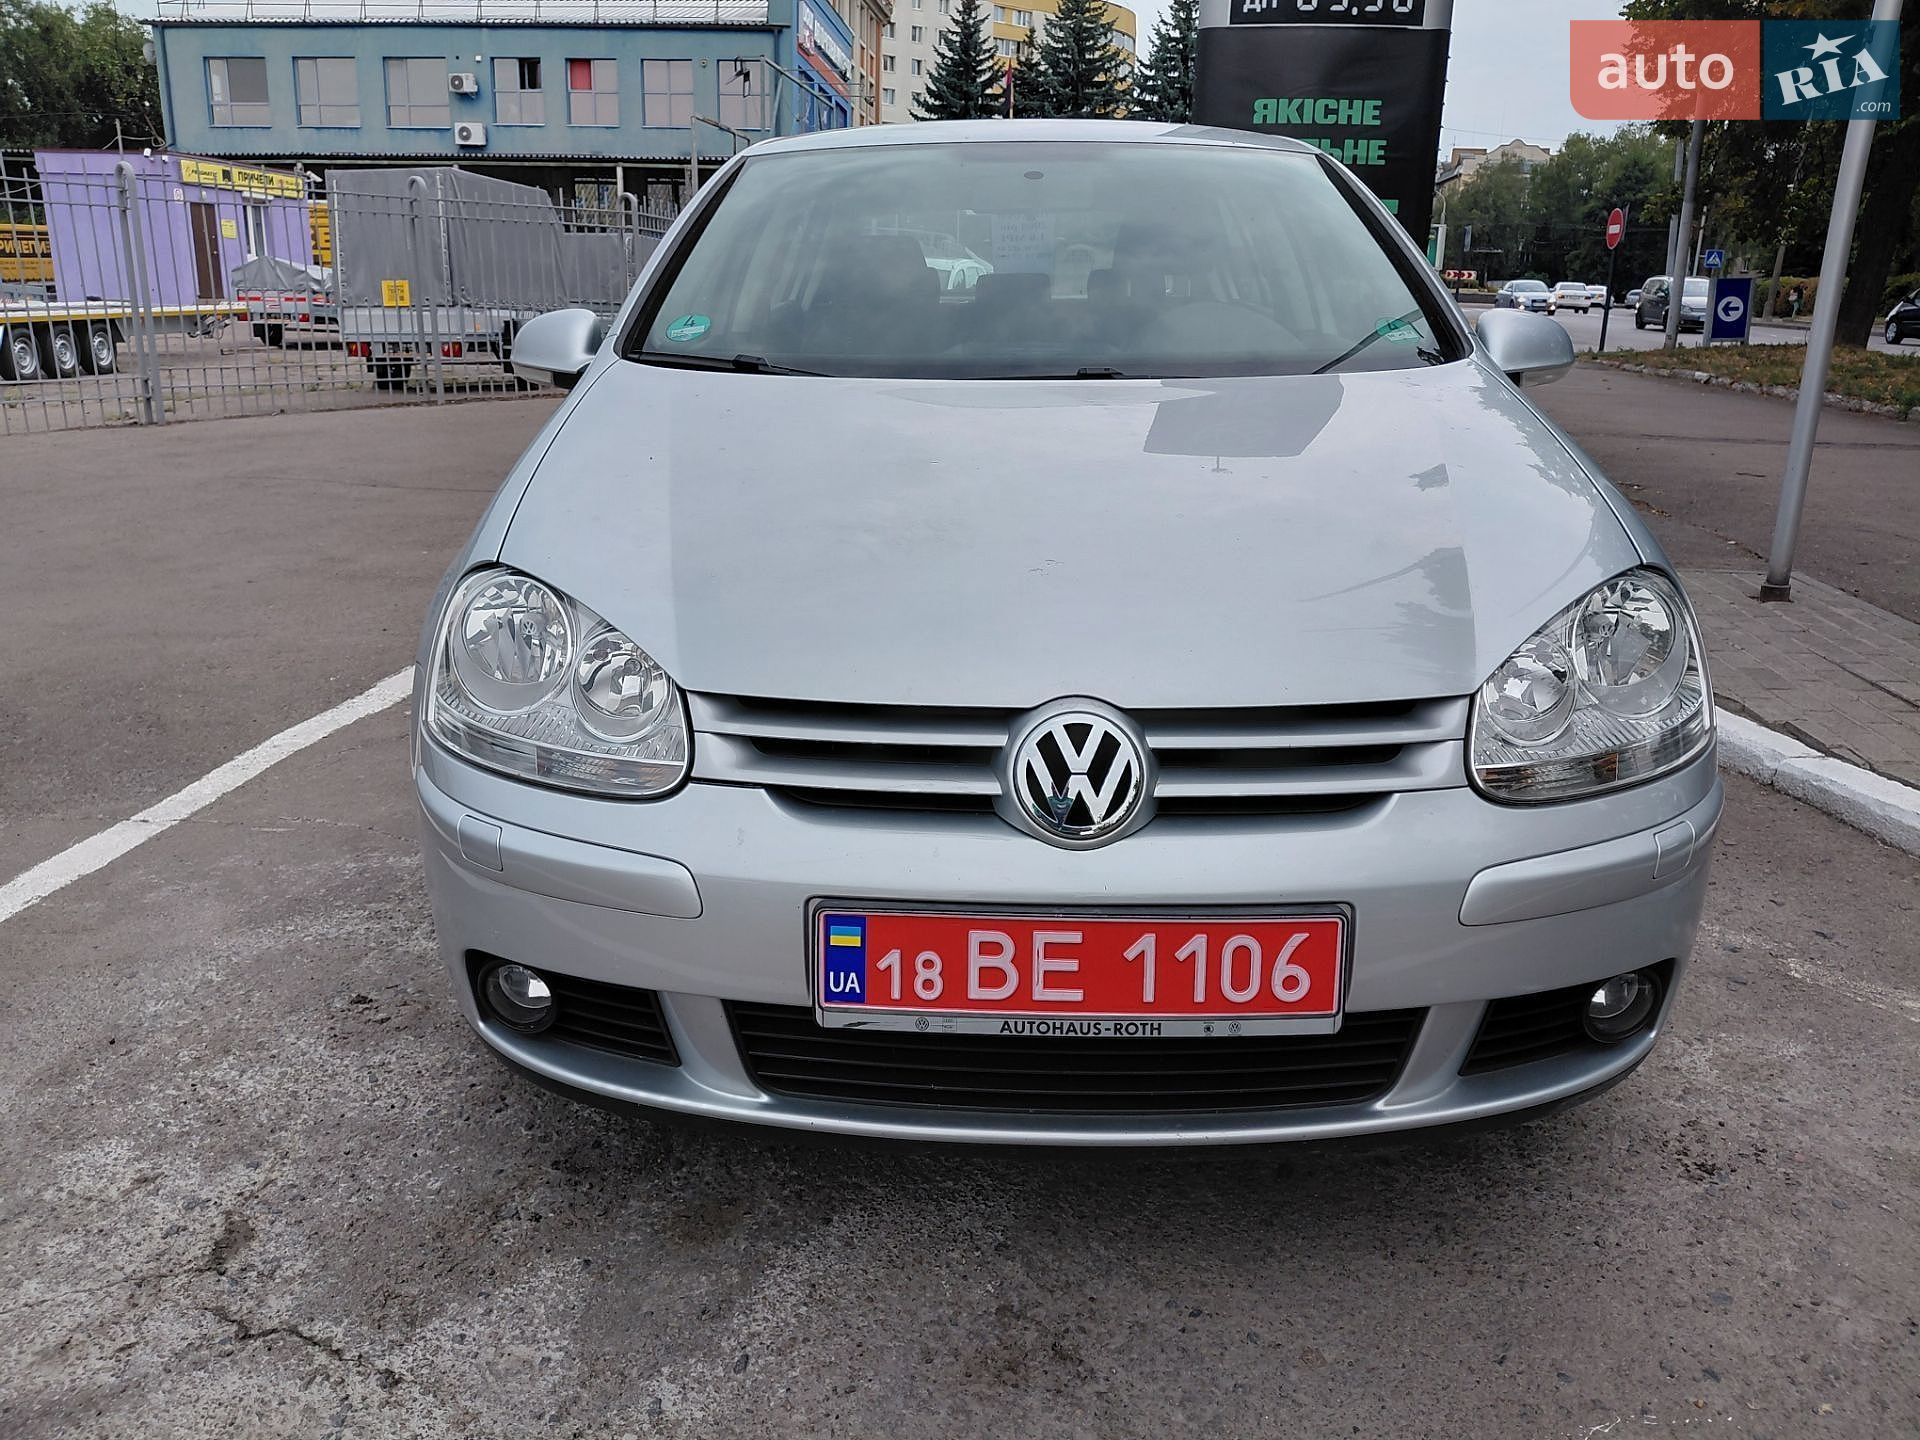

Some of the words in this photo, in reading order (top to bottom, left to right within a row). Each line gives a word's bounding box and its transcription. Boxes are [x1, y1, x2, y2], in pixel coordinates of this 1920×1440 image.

[1253, 98, 1383, 126] ЯКІСНЕ
[876, 948, 944, 1001] 18
[967, 930, 1086, 1001] BE
[1123, 932, 1312, 1004] 1106
[829, 971, 861, 994] UA
[1000, 1020, 1163, 1037] AUTOHAUS-ROTH
